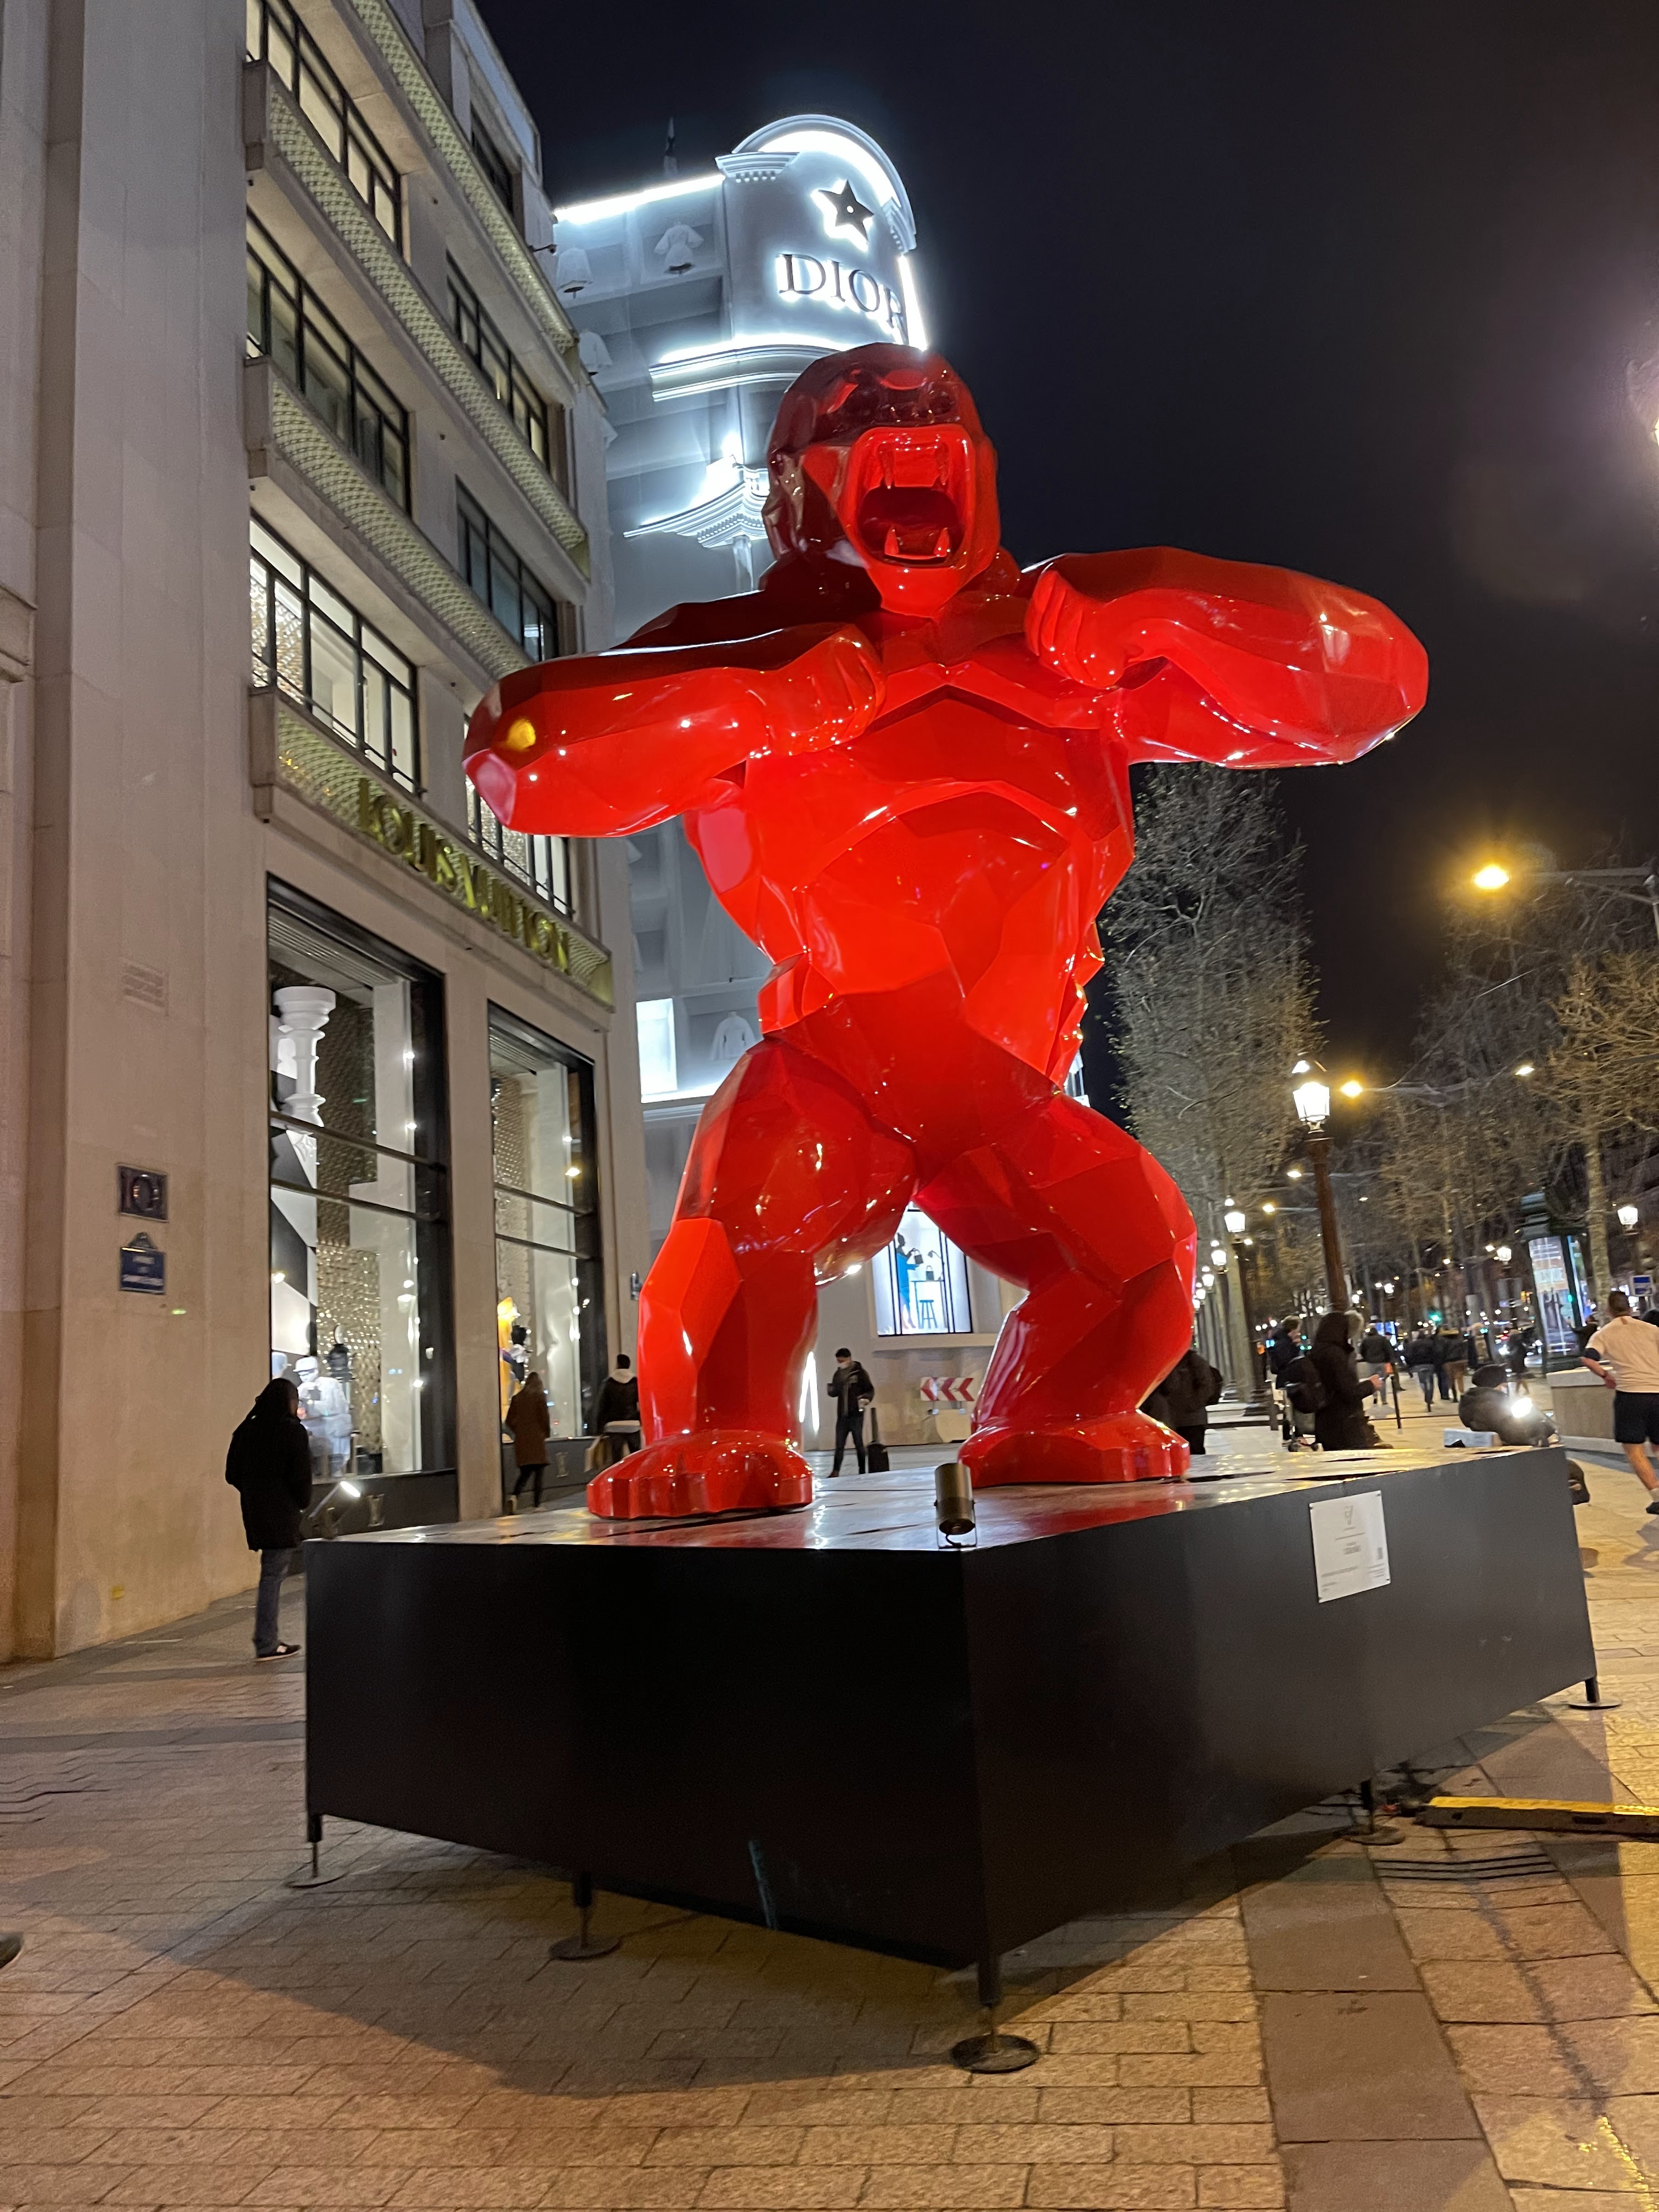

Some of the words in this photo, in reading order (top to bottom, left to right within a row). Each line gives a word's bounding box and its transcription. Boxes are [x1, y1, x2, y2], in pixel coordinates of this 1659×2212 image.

[776, 253, 909, 345] DIOR
[358, 777, 456, 892] LOUIS
[458, 852, 569, 975] VUITTON
